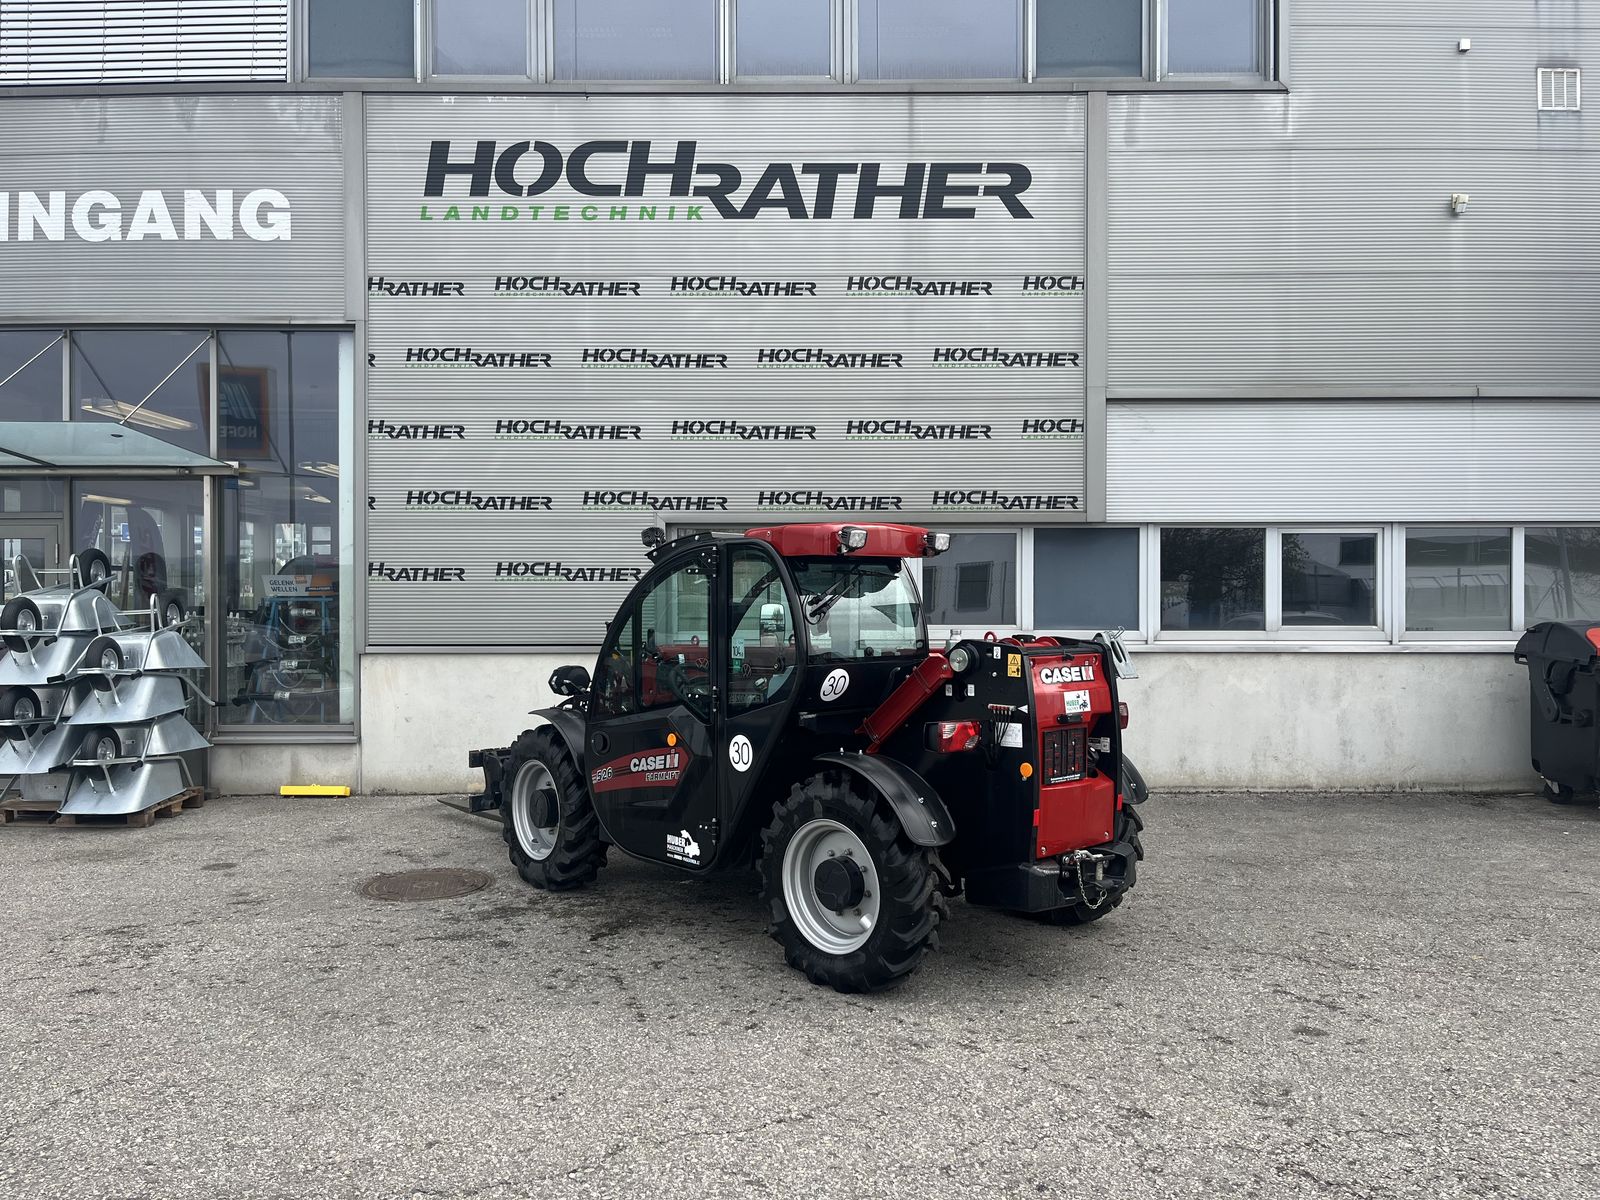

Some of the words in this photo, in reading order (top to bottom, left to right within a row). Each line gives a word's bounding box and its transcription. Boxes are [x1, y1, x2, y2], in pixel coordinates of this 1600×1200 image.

[420, 205, 704, 221] LANDTECHNIK
[1040, 667, 1082, 684] CASE
[822, 675, 847, 697] 30
[731, 741, 750, 765] 30
[630, 755, 665, 772] CASE
